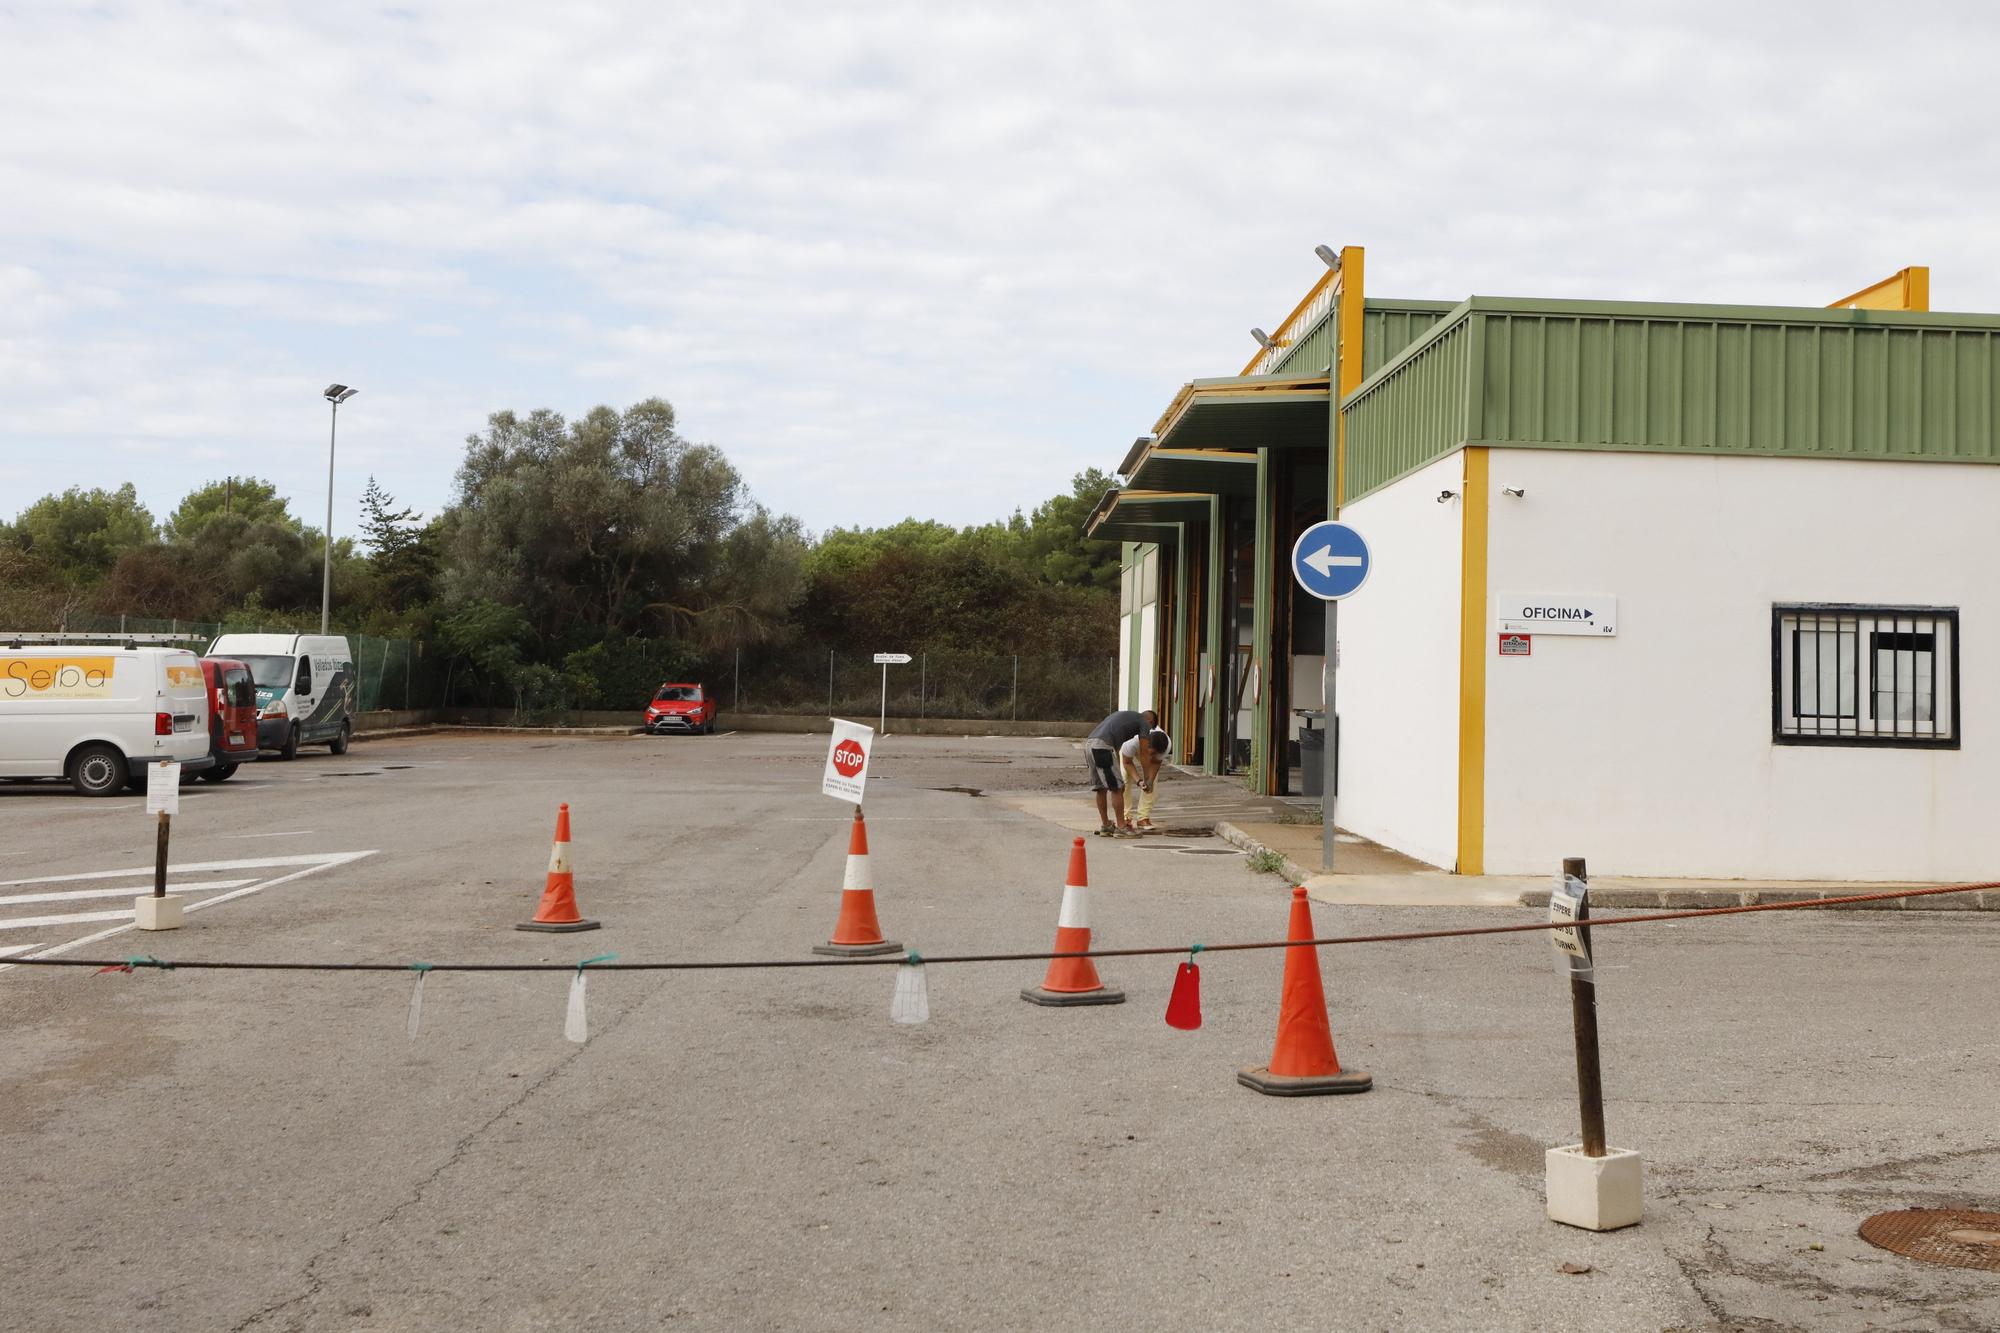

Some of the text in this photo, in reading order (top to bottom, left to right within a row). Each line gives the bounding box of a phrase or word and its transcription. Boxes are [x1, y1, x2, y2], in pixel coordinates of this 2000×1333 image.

[1523, 607, 1582, 619] OFICINA
[5, 661, 106, 697] Seiba
[835, 750, 862, 767] STOP
[1554, 903, 1571, 916] ESPERE
[1554, 938, 1577, 950] TURNO
